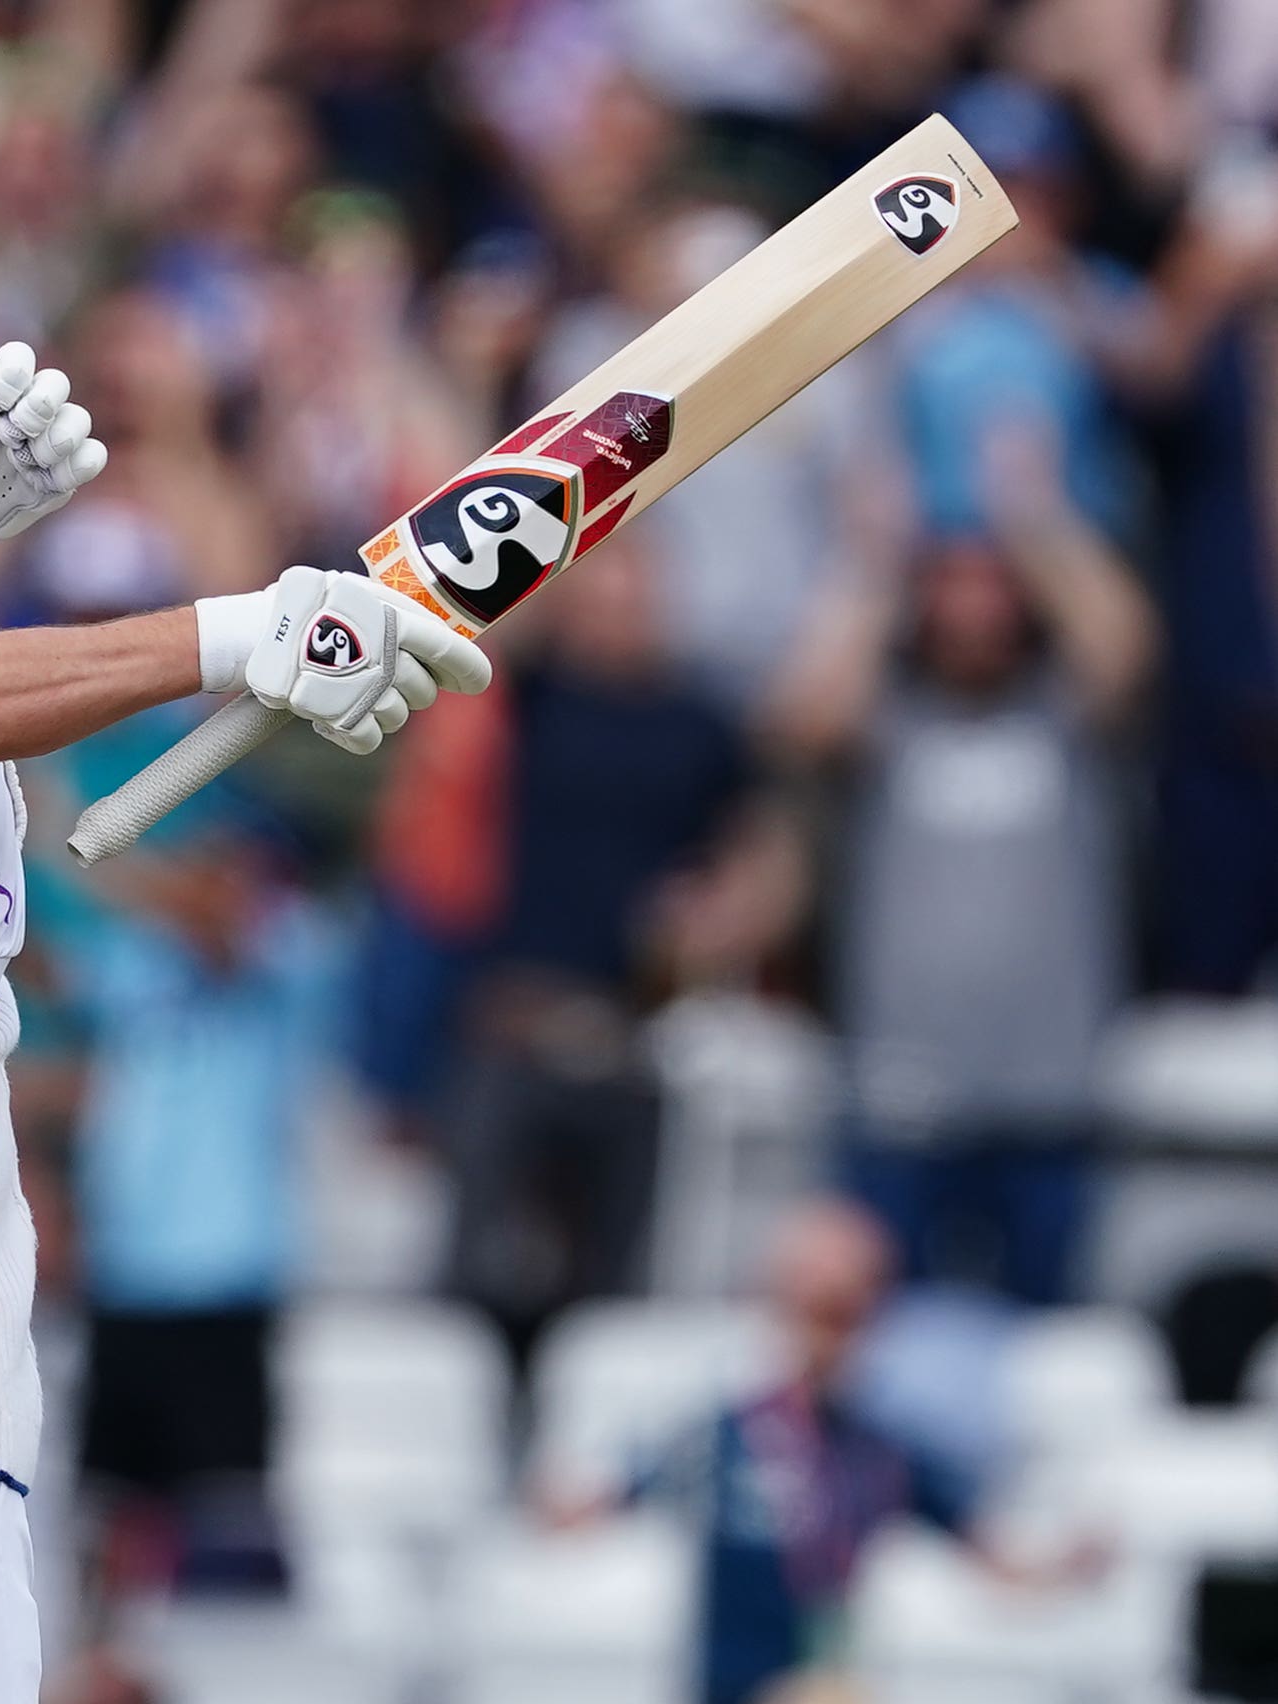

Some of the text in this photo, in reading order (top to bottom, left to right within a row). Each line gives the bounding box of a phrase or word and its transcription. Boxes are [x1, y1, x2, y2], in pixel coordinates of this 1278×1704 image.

[582, 428, 623, 454] become
[420, 483, 570, 592] SG
[274, 614, 291, 642] TEST
